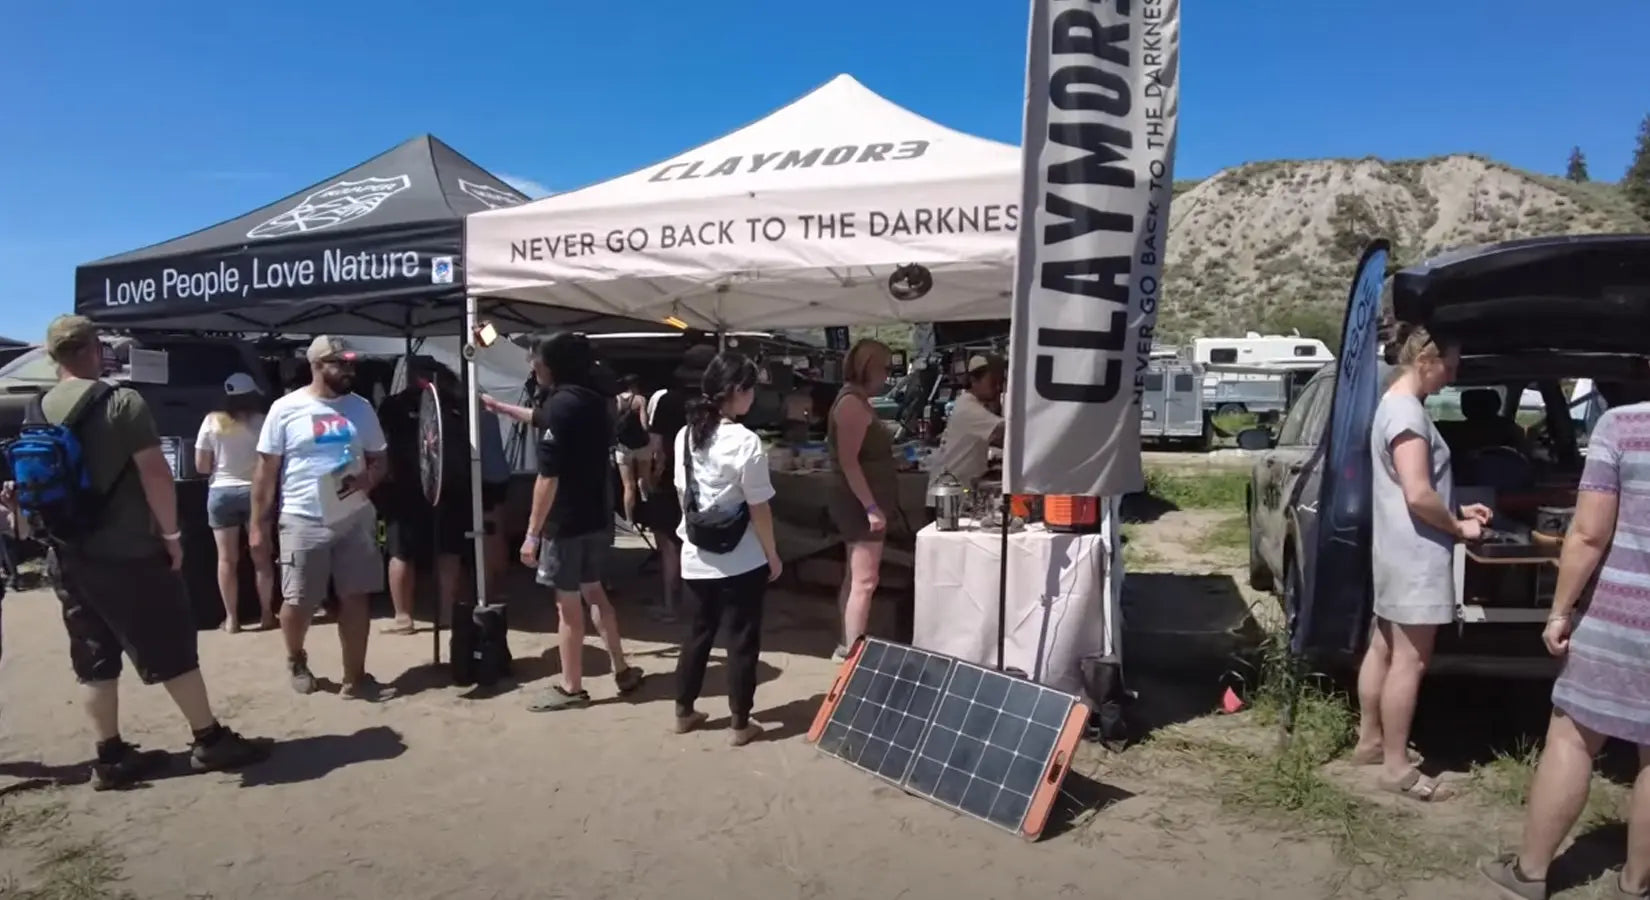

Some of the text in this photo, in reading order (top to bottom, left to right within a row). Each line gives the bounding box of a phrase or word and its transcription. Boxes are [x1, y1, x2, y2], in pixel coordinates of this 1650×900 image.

[1145, 107, 1165, 150] THE
[647, 139, 931, 182] CLAYMOR3
[1149, 159, 1166, 191] TO
[1034, 0, 1136, 403] CLAYMOR
[510, 232, 595, 263] NEVER
[606, 227, 648, 254] GO
[660, 220, 735, 249] BACK
[746, 216, 786, 243] TO
[798, 212, 856, 240] THE
[1140, 201, 1158, 265] BACK
[105, 249, 419, 306] Love People, Love Nature
[1140, 276, 1157, 314] GO
